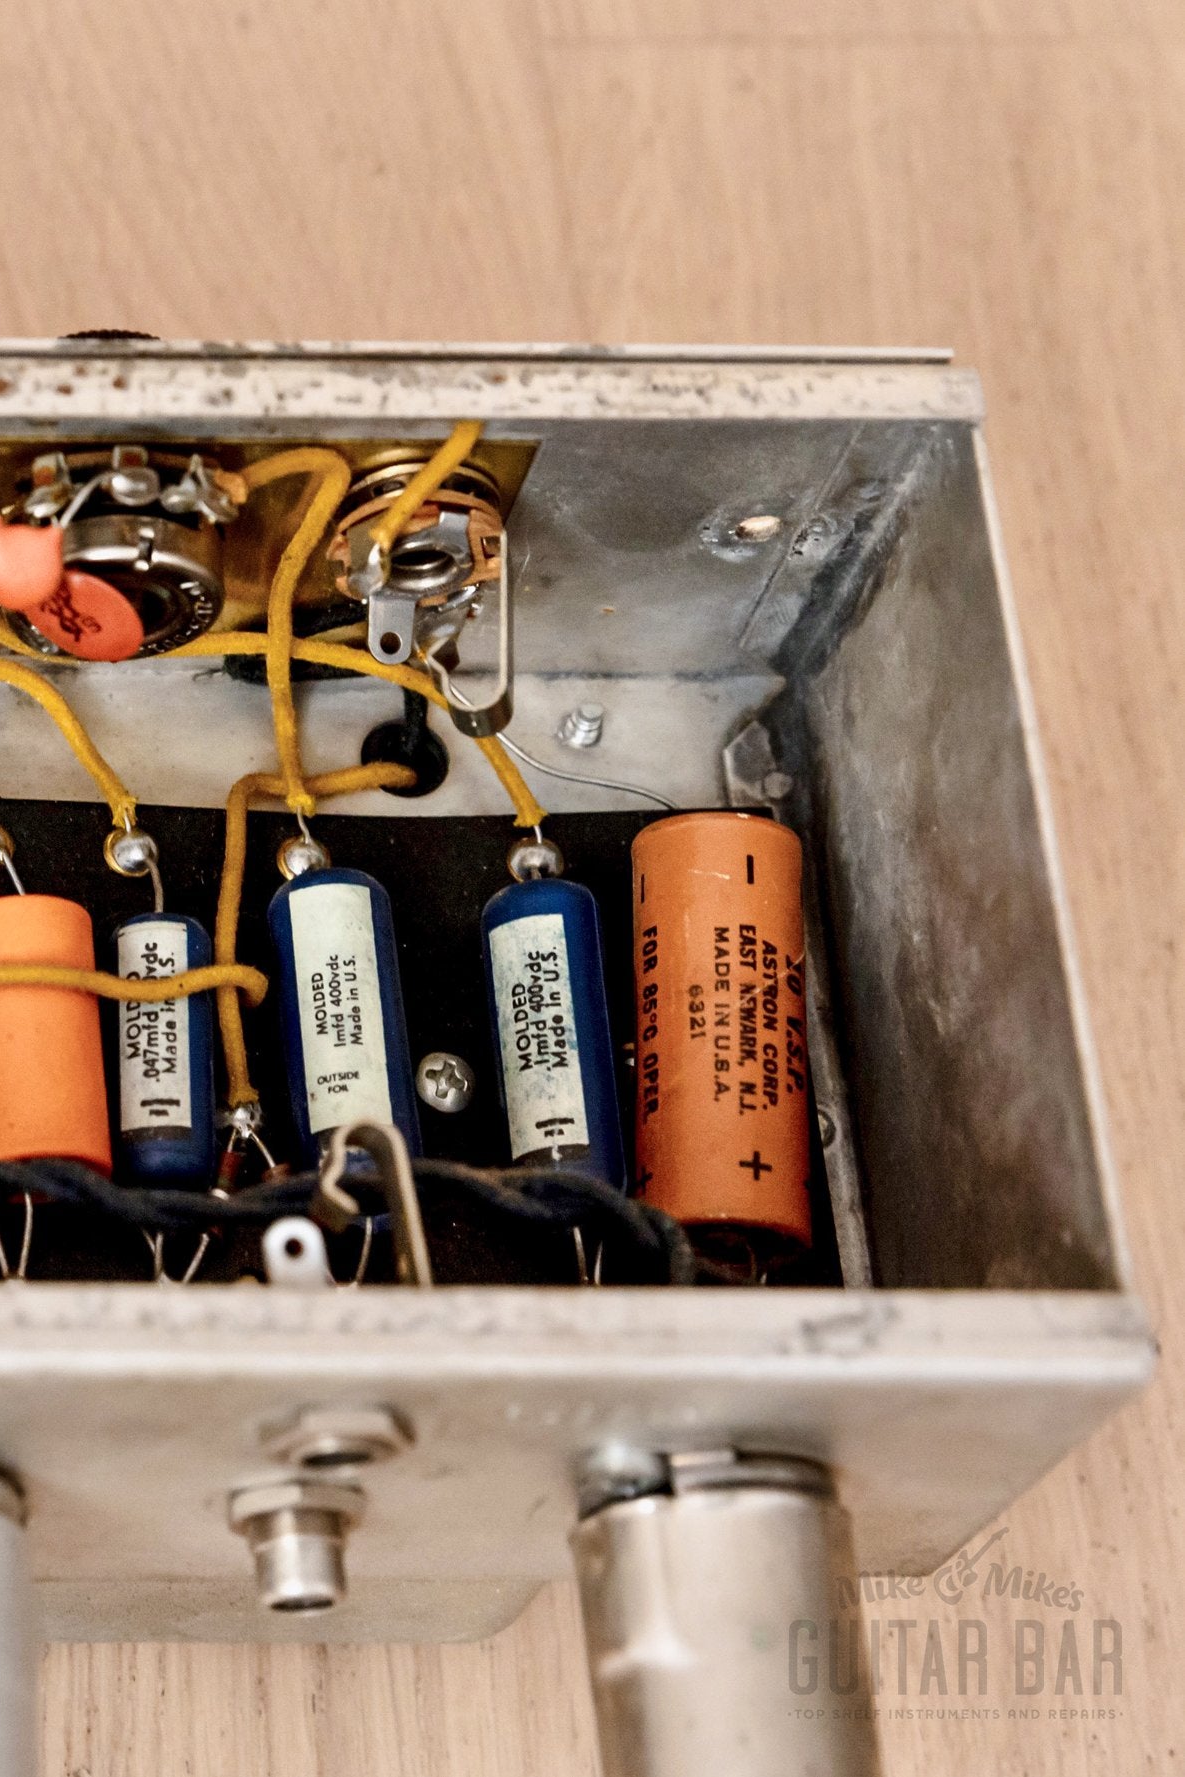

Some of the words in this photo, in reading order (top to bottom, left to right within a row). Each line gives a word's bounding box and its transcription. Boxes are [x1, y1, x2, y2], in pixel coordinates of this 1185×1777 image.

[343, 955, 357, 981] U.S.
[541, 947, 559, 982] U.S.
[641, 926, 658, 973] FOR
[714, 927, 730, 992] MADE
[739, 924, 757, 969] EAST
[311, 972, 328, 1035] MOLDED
[328, 954, 342, 1007] 400vdc
[348, 988, 359, 1000] in
[526, 951, 546, 1012] 400vdc
[546, 991, 561, 1007] in
[762, 940, 778, 1030] ASTRON
[126, 972, 141, 1059] MOLDD
[349, 1006, 364, 1045] Made
[512, 983, 533, 1071] MOLDED
[548, 1014, 568, 1068] Made
[715, 1003, 730, 1027] IN
[143, 1012, 160, 1082] .047mfd
[161, 1021, 177, 1074] Made
[317, 1070, 360, 1085] OUTSIDE
[739, 1081, 756, 1115] N.J.
[763, 1043, 778, 1111] CORP.
